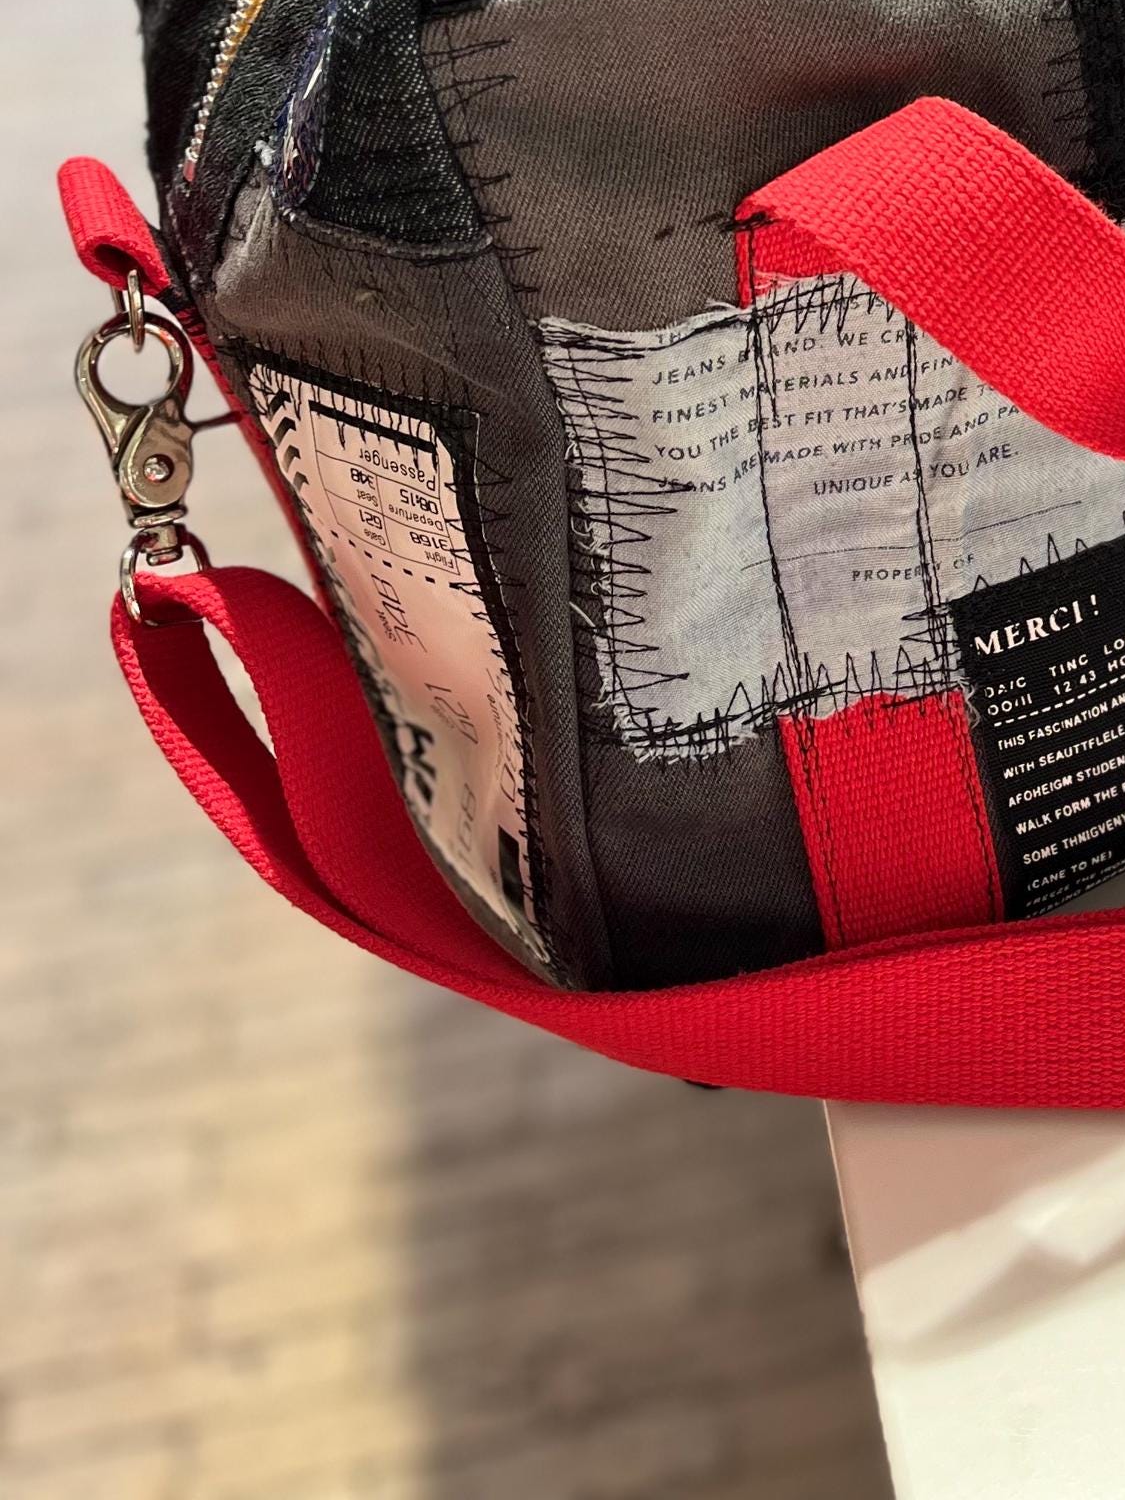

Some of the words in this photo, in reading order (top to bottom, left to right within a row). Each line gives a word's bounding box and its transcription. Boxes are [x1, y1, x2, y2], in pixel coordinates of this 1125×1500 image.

[652, 354, 726, 386] JEANS
[838, 329, 868, 347] WE
[652, 394, 728, 424] FINEST
[739, 369, 859, 401] MATERIALS
[869, 365, 910, 382] AND
[654, 444, 701, 461] YOU
[709, 425, 740, 452] THE
[747, 414, 796, 432] BEST
[804, 409, 834, 426] FIT
[842, 398, 908, 422] THAT'S
[912, 385, 968, 412] MADE
[733, 453, 758, 484] ARE
[761, 444, 824, 466] MADE
[832, 438, 882, 455] WITH
[949, 412, 989, 439] AND
[357, 447, 437, 490] Passenger
[813, 475, 894, 496] UNIQUE
[929, 461, 970, 478] YOU
[975, 443, 1020, 468] ARE.
[387, 504, 444, 530] Departure
[398, 488, 439, 513] 08:15
[357, 509, 383, 529] 621
[408, 531, 447, 550] 3168
[423, 550, 454, 568] Flight
[952, 553, 976, 570] OF
[1049, 653, 1087, 678] TINC
[998, 732, 1025, 752] THIS
[1028, 700, 1107, 742] FASCINATION
[1003, 759, 1035, 780] WITH
[1038, 724, 1125, 767] SEAUTTFLELE
[1016, 812, 1051, 835] WALK
[1054, 796, 1091, 821] FORM
[1094, 785, 1117, 803] THE
[1023, 843, 1058, 865] SOME
[1071, 861, 1087, 874] TO
